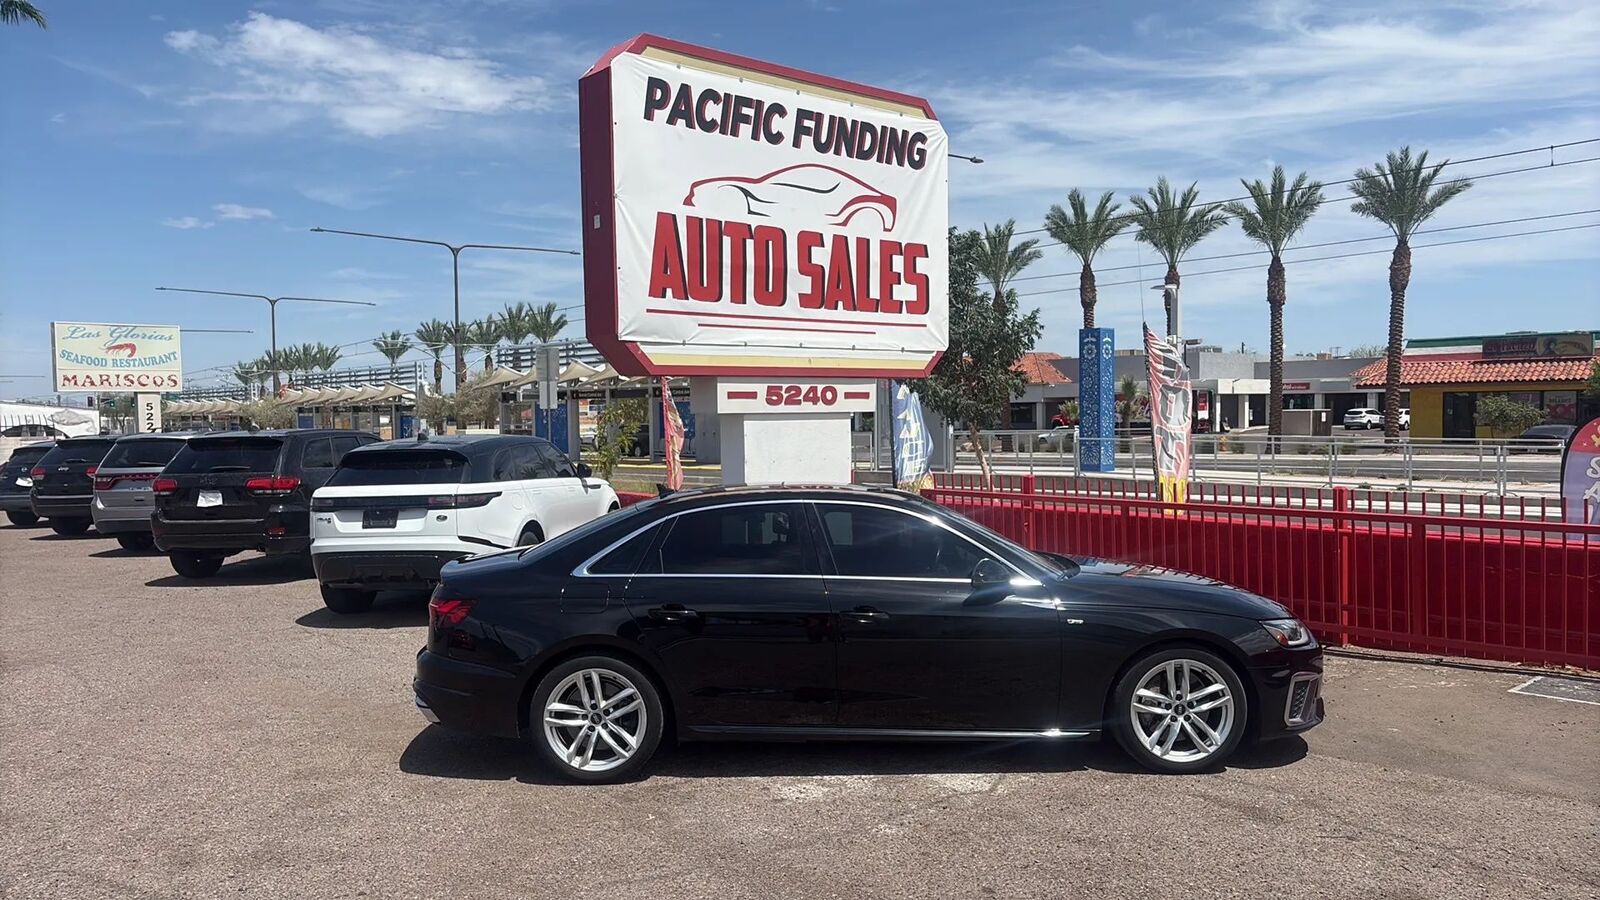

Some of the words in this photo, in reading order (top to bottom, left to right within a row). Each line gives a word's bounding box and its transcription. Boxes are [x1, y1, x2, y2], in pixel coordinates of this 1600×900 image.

[643, 76, 788, 145] PACIFIC
[792, 107, 928, 170] FUNDING
[648, 211, 788, 307] AUTO
[797, 230, 929, 315] SALES
[62, 326, 101, 340] Las
[104, 326, 173, 346] Glorias
[60, 349, 107, 367] SEAFOOD
[112, 352, 178, 368] RESTAURANT
[61, 374, 178, 387] MARISCOS
[765, 385, 838, 406] 5240
